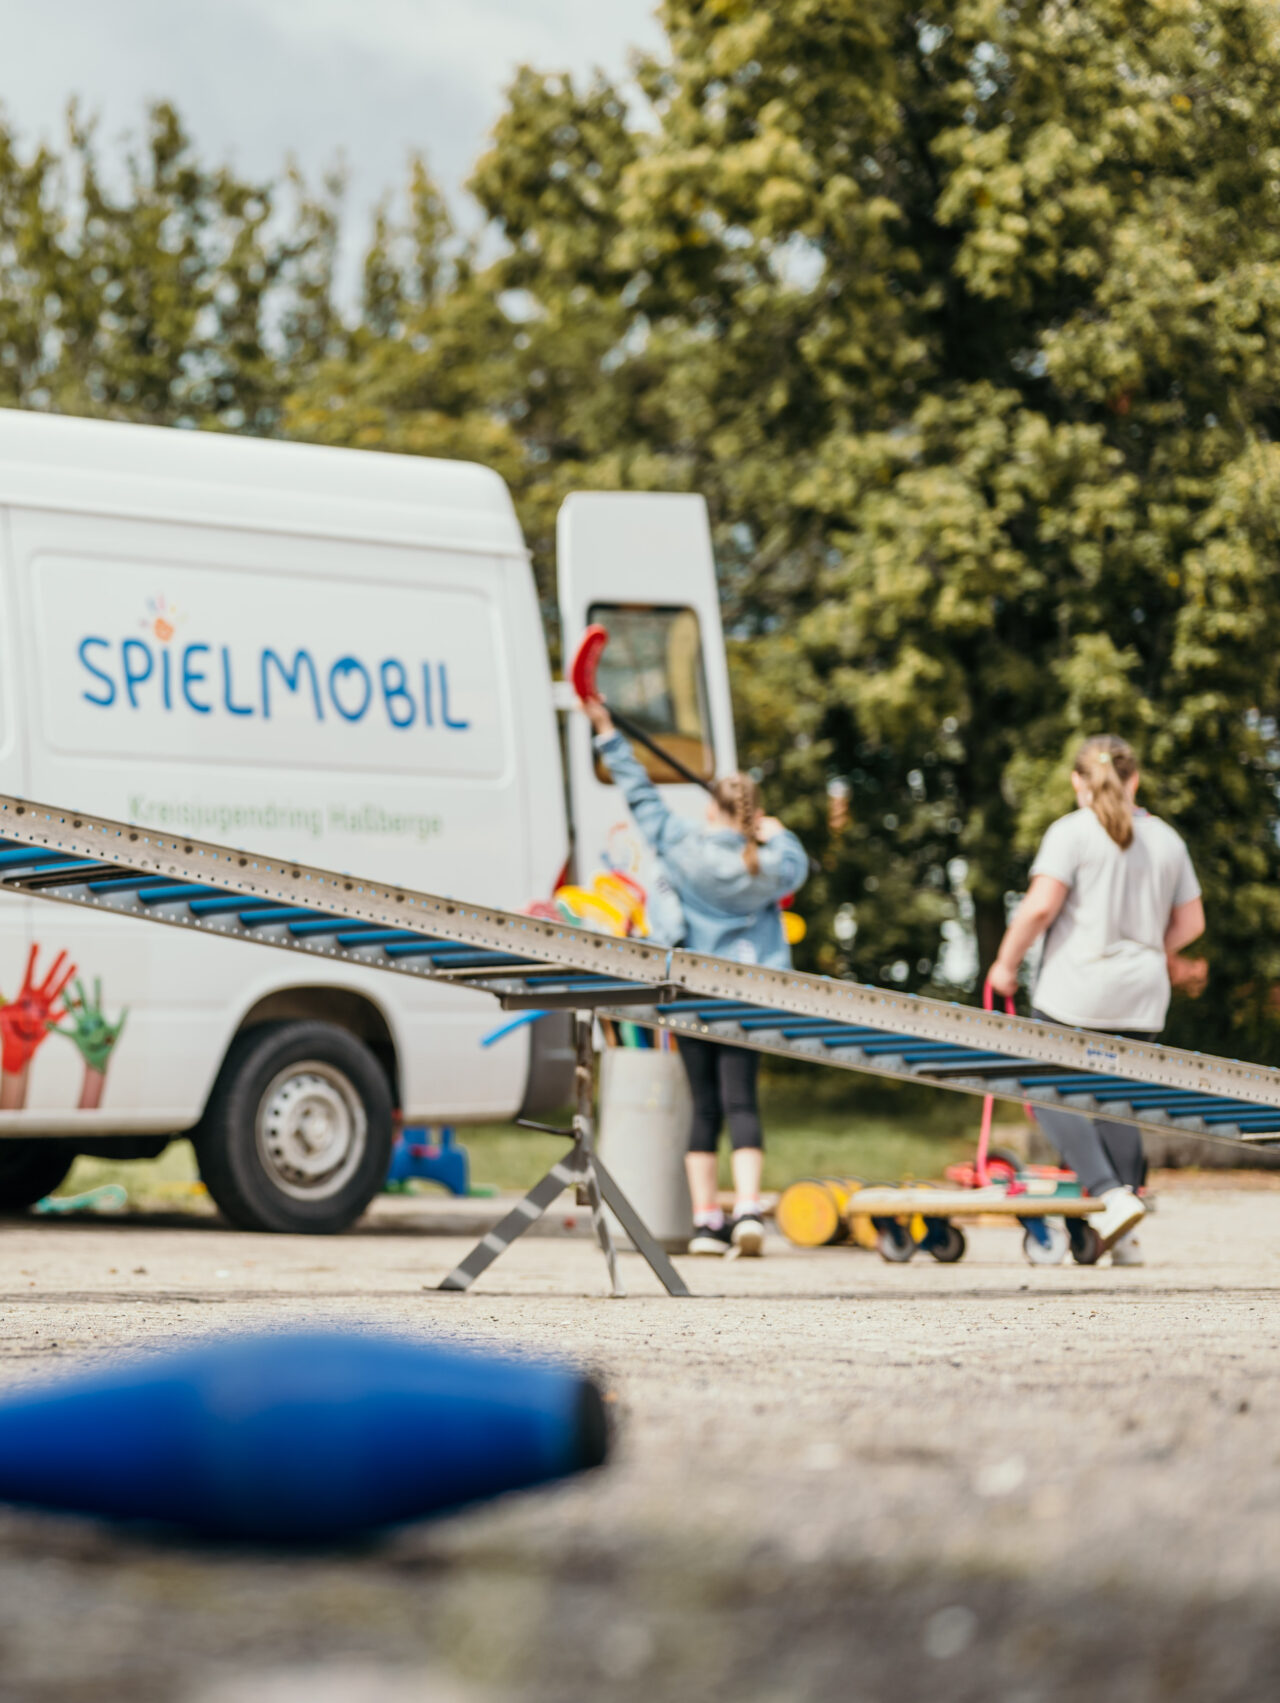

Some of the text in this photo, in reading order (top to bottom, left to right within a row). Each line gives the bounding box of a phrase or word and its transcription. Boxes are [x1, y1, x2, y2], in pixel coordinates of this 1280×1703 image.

[77, 635, 471, 731] SPIELMOBIL
[128, 796, 443, 843] Kreisjugendring Haßberge
